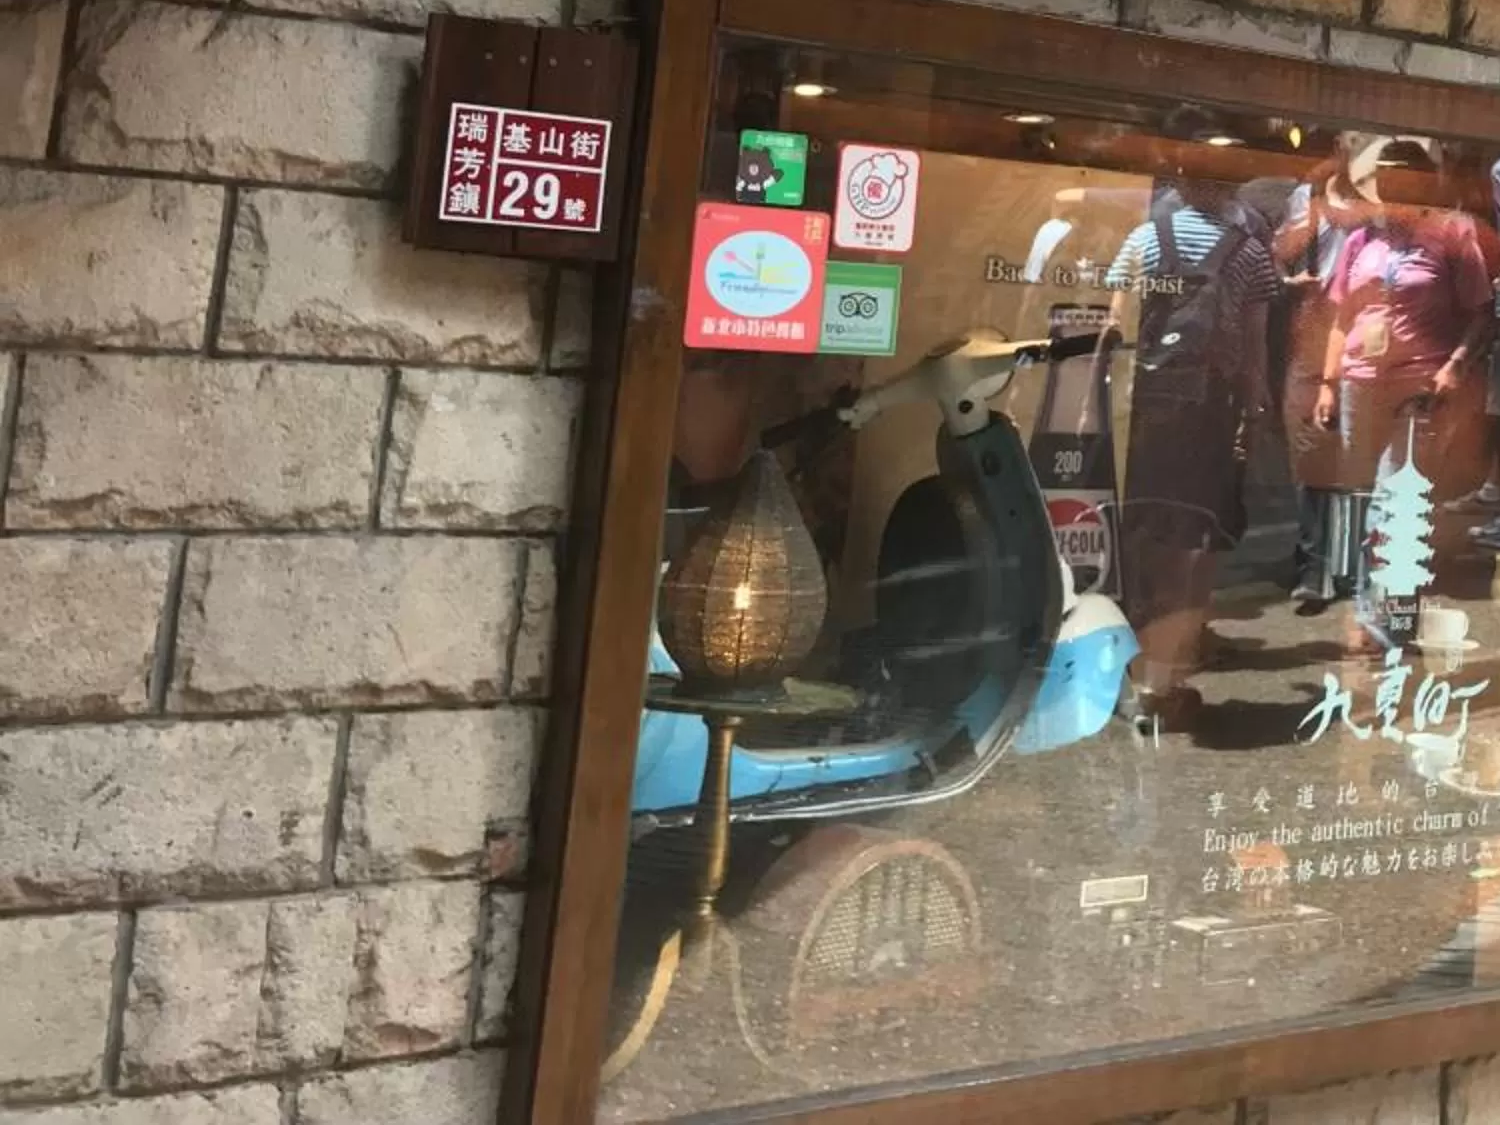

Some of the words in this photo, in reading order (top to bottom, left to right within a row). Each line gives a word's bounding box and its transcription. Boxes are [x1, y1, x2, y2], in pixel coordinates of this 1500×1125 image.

[503, 122, 600, 160] 基山街
[448, 112, 489, 215] 瑞芳鎮
[1055, 265, 1077, 286] to
[1140, 274, 1186, 299] past
[1054, 450, 1083, 475] 200
[1294, 647, 1491, 764] 九重町
[1202, 826, 1259, 853] Enjoy
[1271, 822, 1303, 845] the
[1311, 812, 1404, 843] authentic
[1413, 809, 1463, 832] charm
[1467, 802, 1488, 827] of
